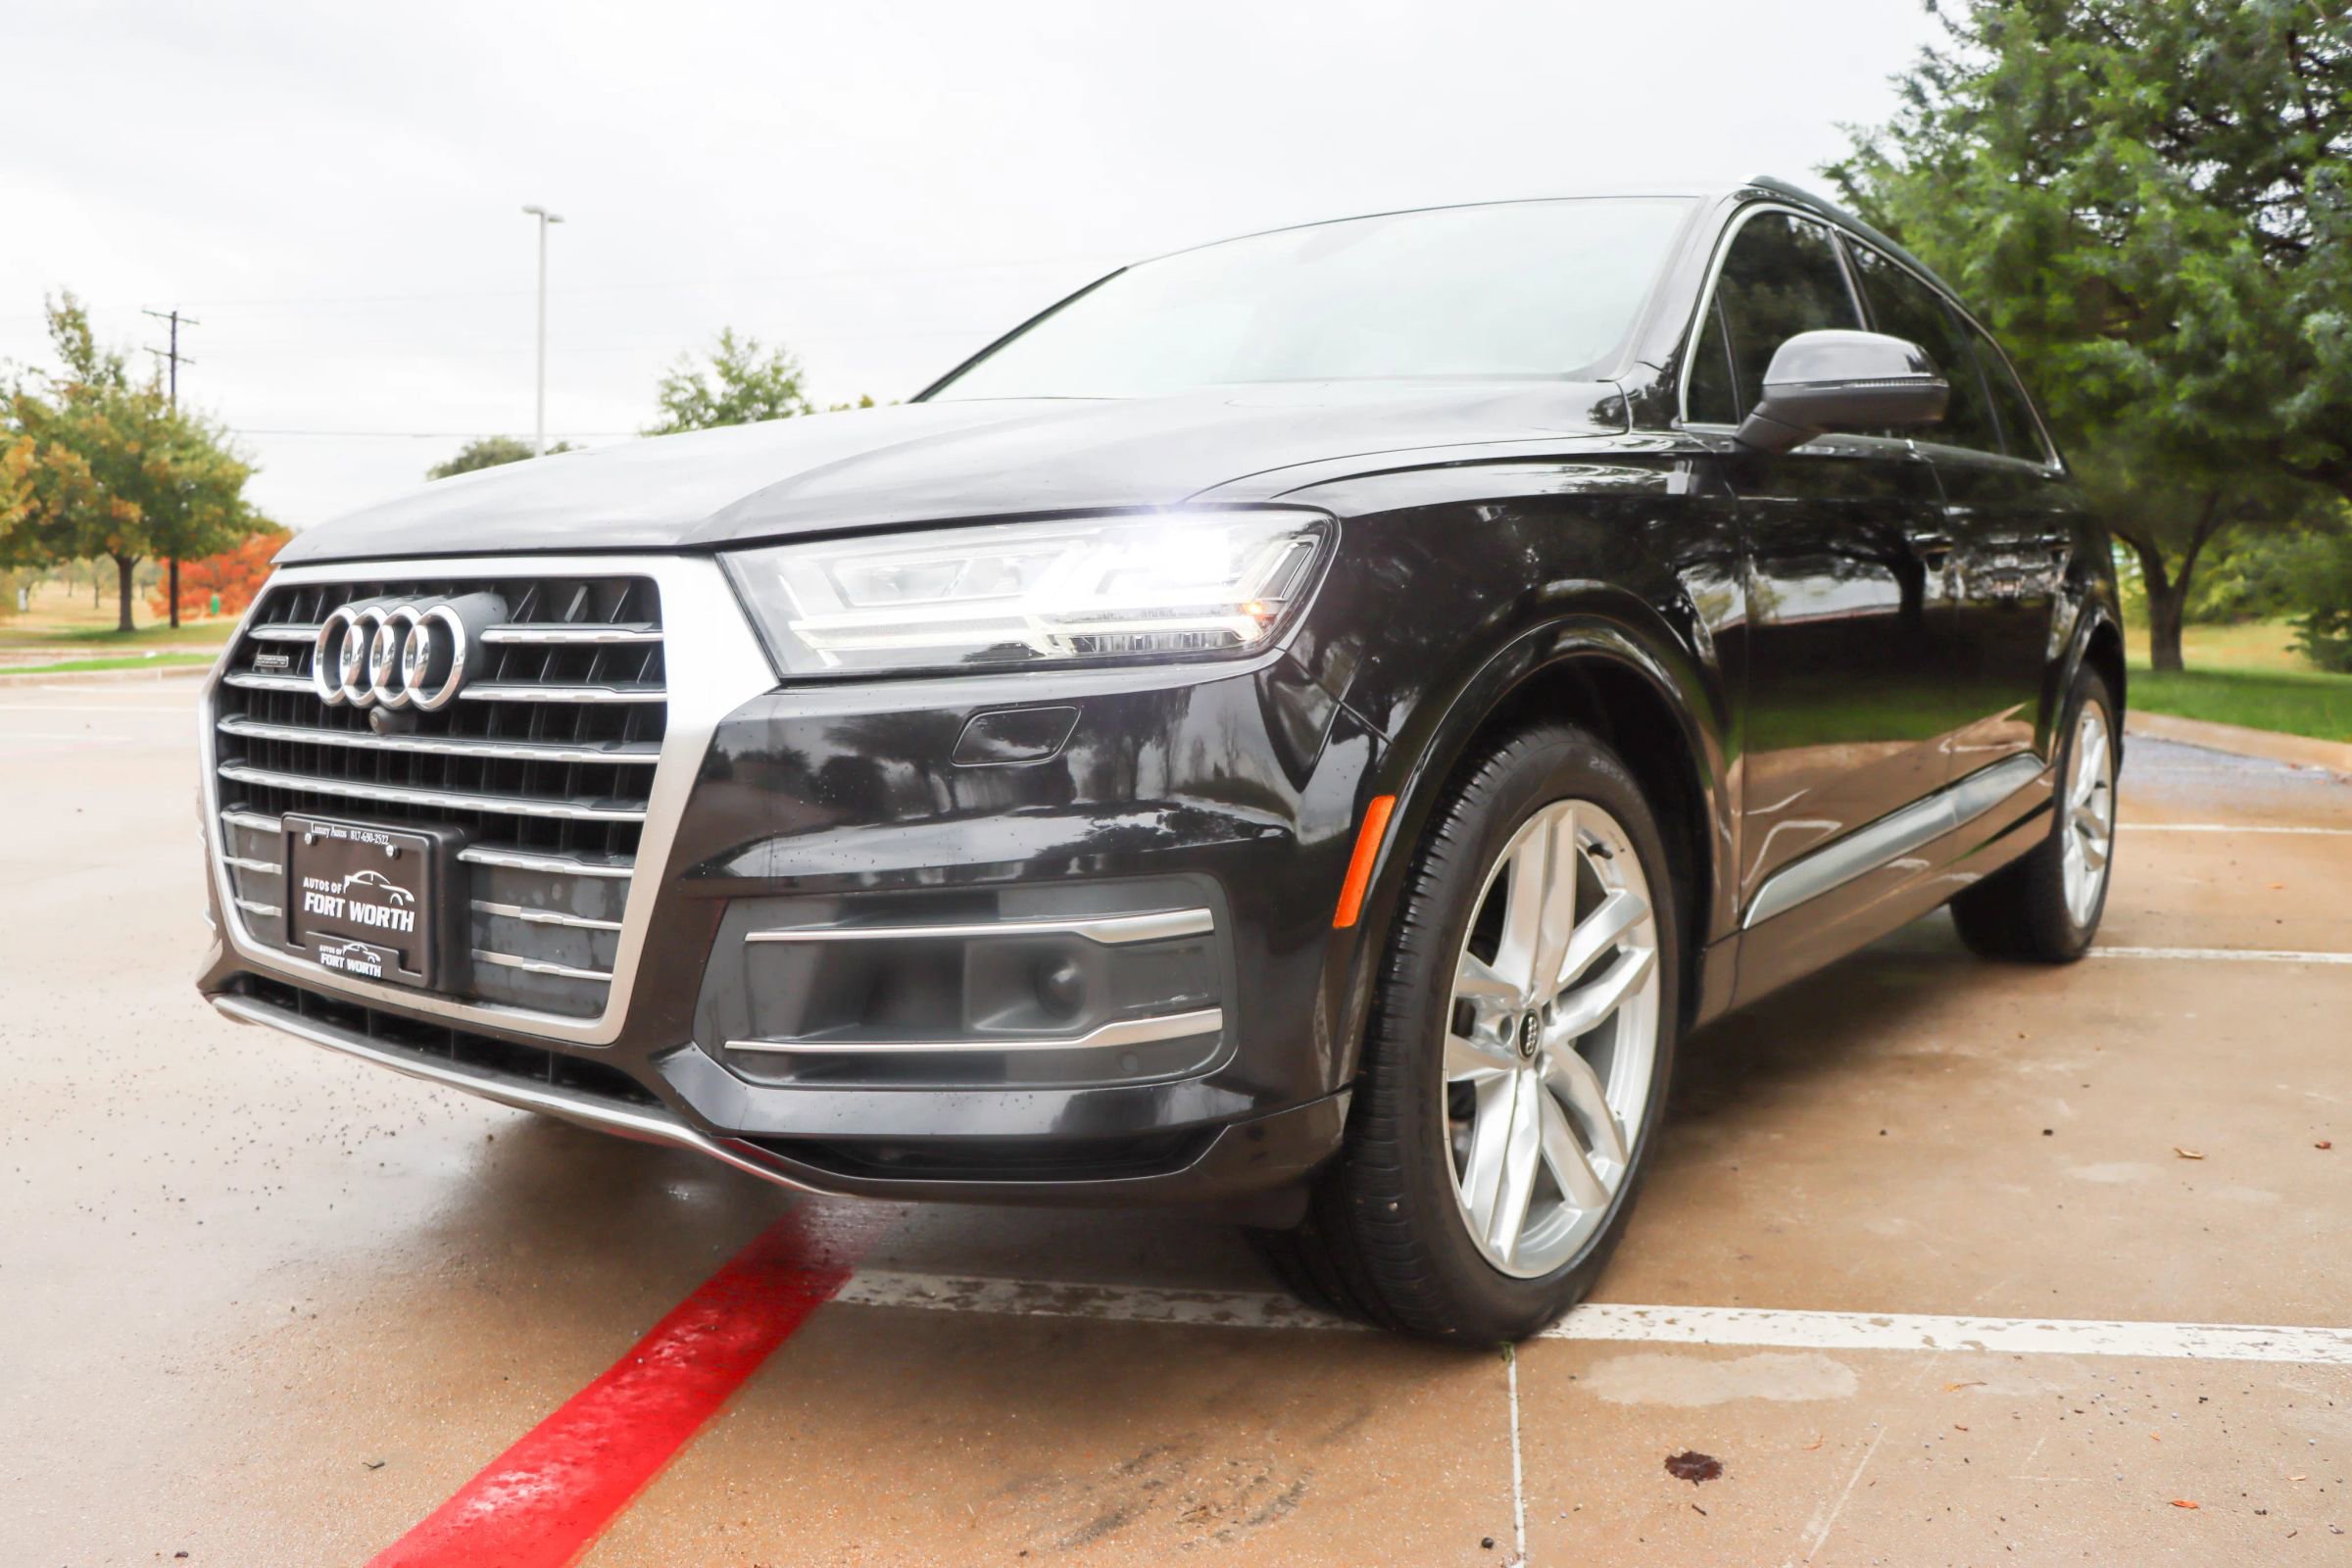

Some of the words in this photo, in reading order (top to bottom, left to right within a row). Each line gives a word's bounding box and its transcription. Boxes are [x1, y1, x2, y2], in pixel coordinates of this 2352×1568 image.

[303, 877, 330, 894] AUTOS
[330, 882, 343, 895] OF
[304, 891, 346, 918] FORT
[349, 901, 416, 933] WORTH
[320, 953, 345, 969] FORT
[346, 957, 382, 978] WORTH
